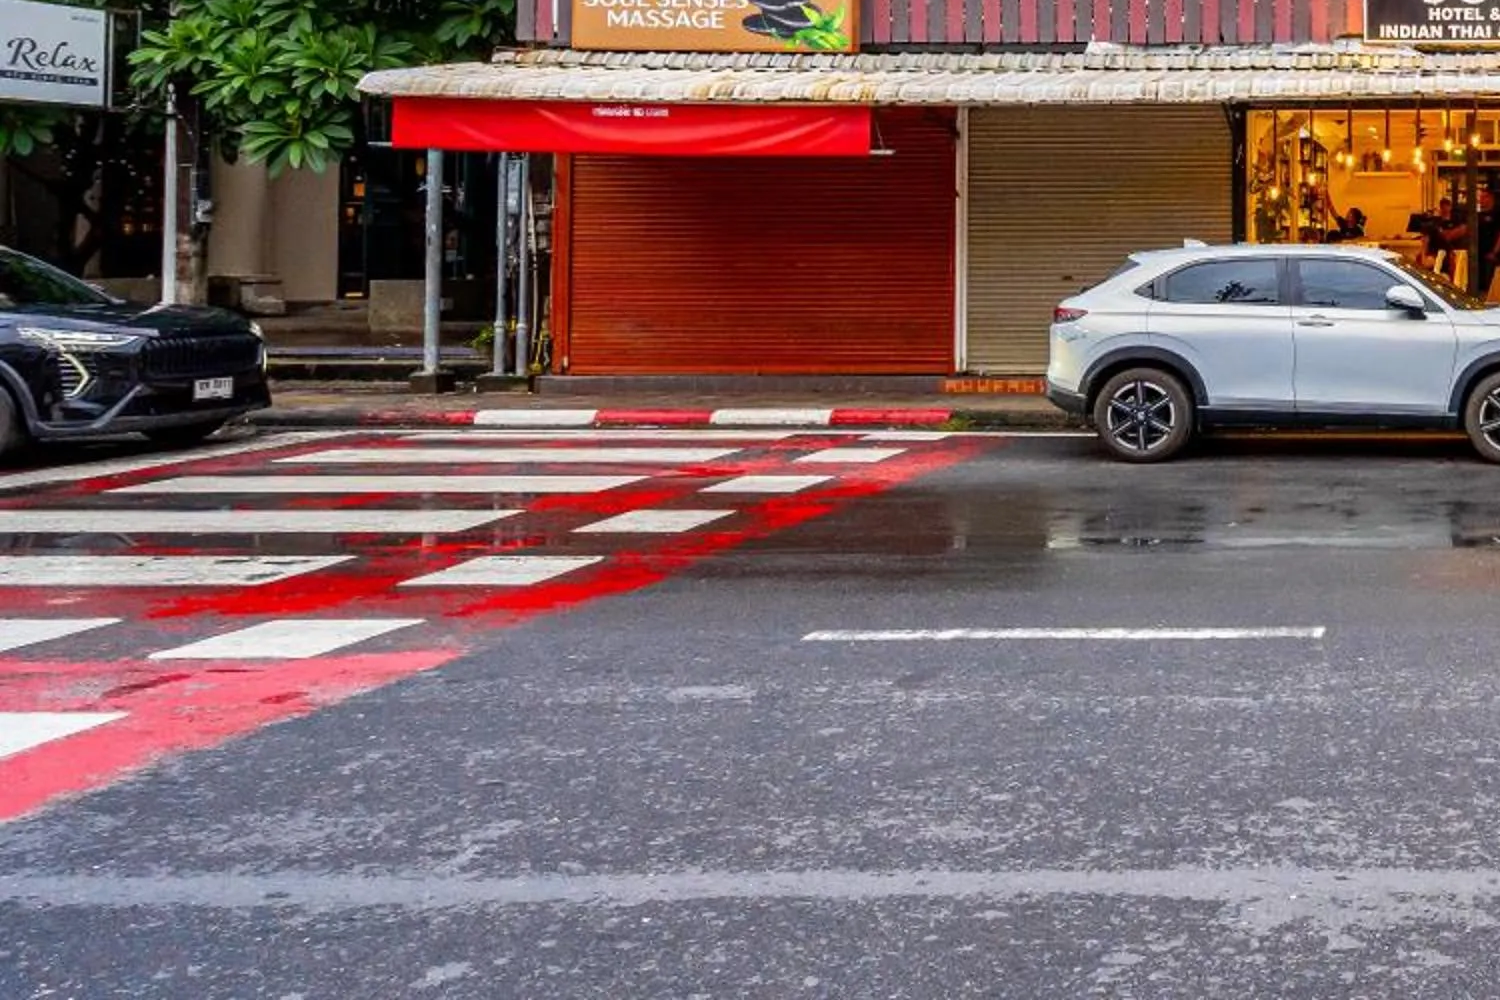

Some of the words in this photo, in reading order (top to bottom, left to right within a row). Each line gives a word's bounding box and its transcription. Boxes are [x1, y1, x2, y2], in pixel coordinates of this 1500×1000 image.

[607, 9, 726, 29] MASSAGE
[1428, 7, 1485, 21] HOTEL
[1379, 24, 1443, 39] INDIAN
[1447, 24, 1492, 39] THAI
[7, 37, 97, 72] Relax
